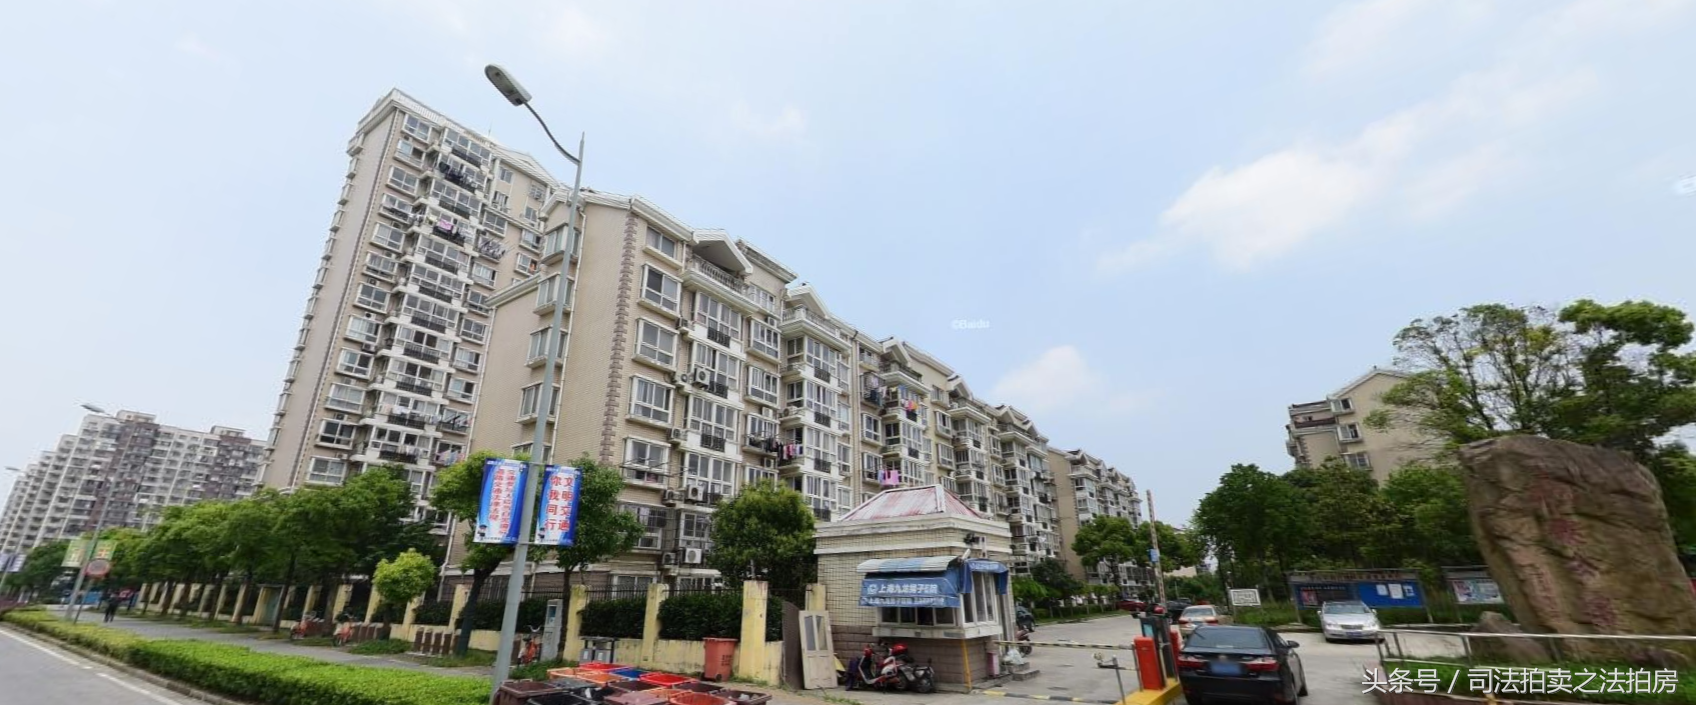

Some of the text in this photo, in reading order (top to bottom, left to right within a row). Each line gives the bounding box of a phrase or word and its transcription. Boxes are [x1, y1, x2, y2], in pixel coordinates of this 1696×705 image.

[545, 475, 562, 530] 你我同行
[557, 476, 574, 532] 文明交通
